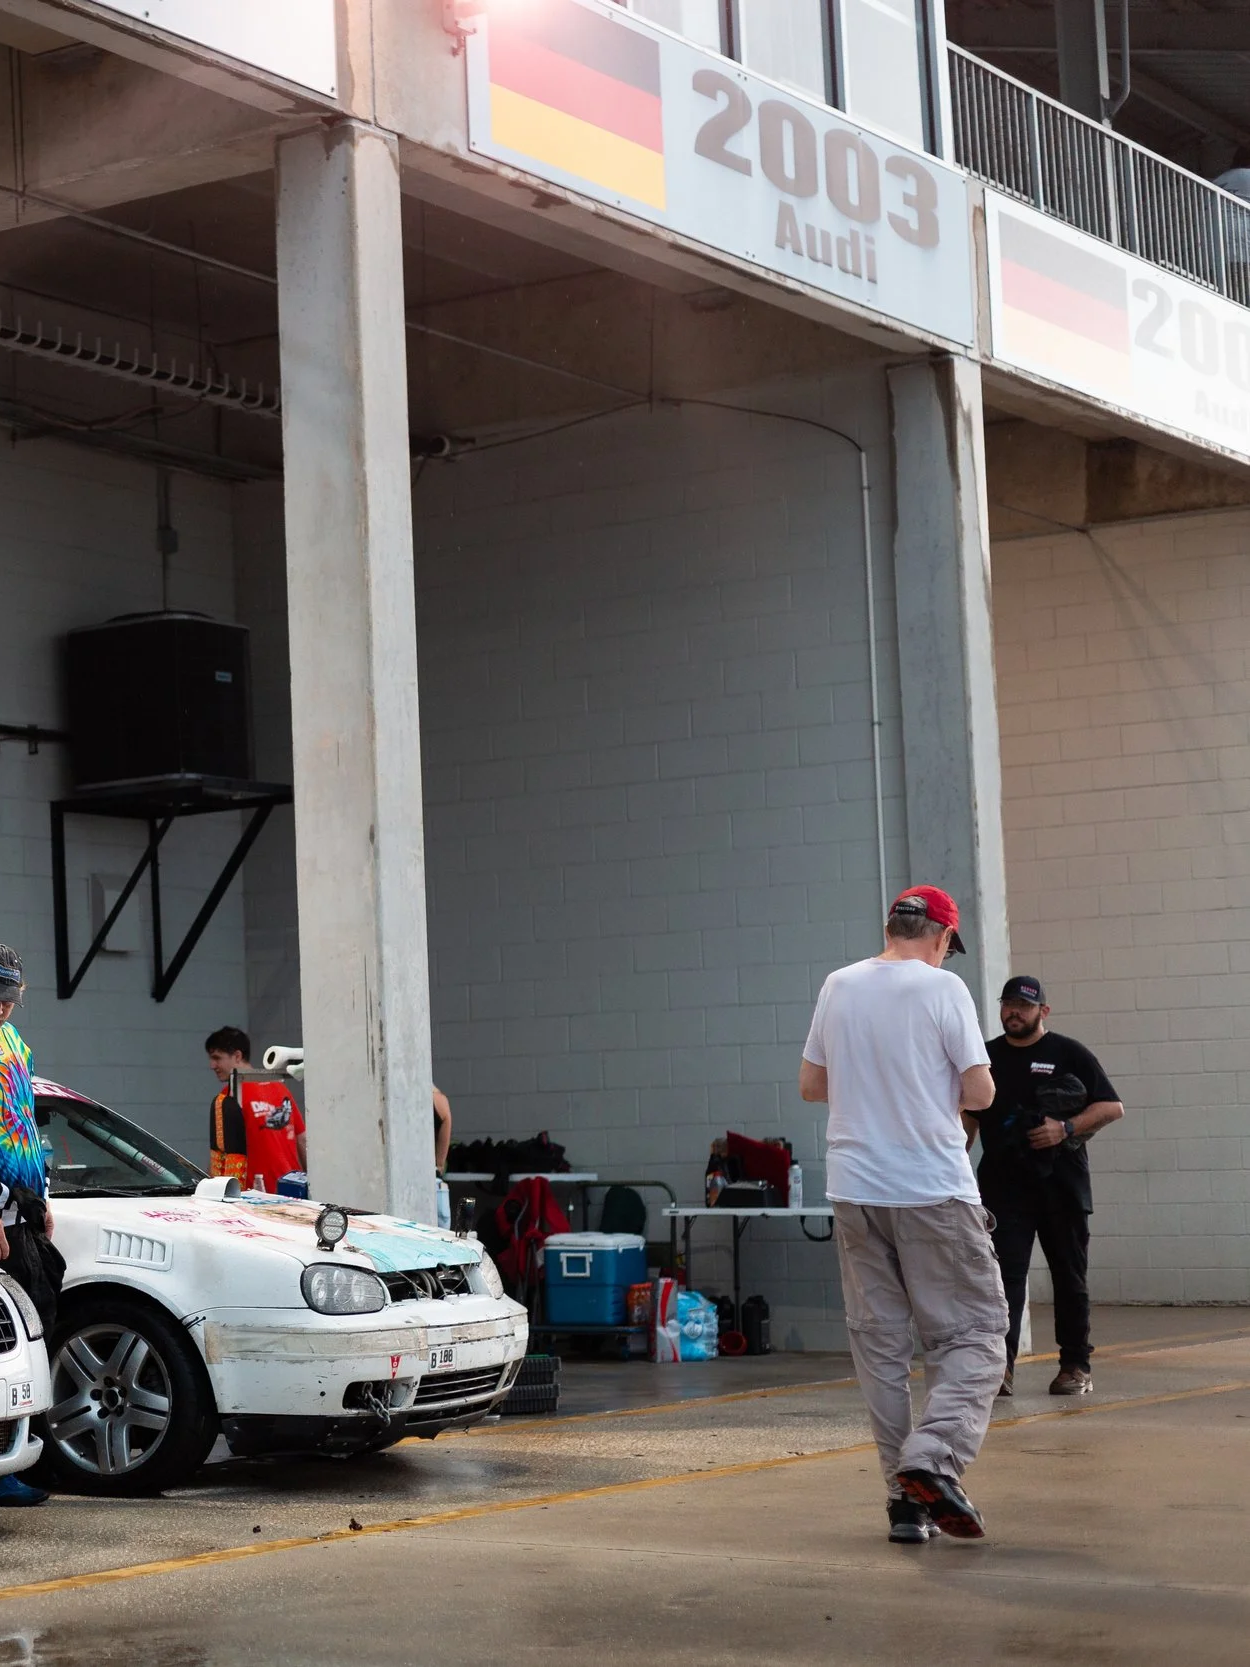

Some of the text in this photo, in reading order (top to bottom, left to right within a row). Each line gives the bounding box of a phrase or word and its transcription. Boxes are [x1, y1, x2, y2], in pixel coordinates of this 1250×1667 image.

[692, 68, 940, 249] 2003
[775, 203, 878, 285] Audi
[431, 1353, 437, 1368] B
[11, 1387, 18, 1406] B
